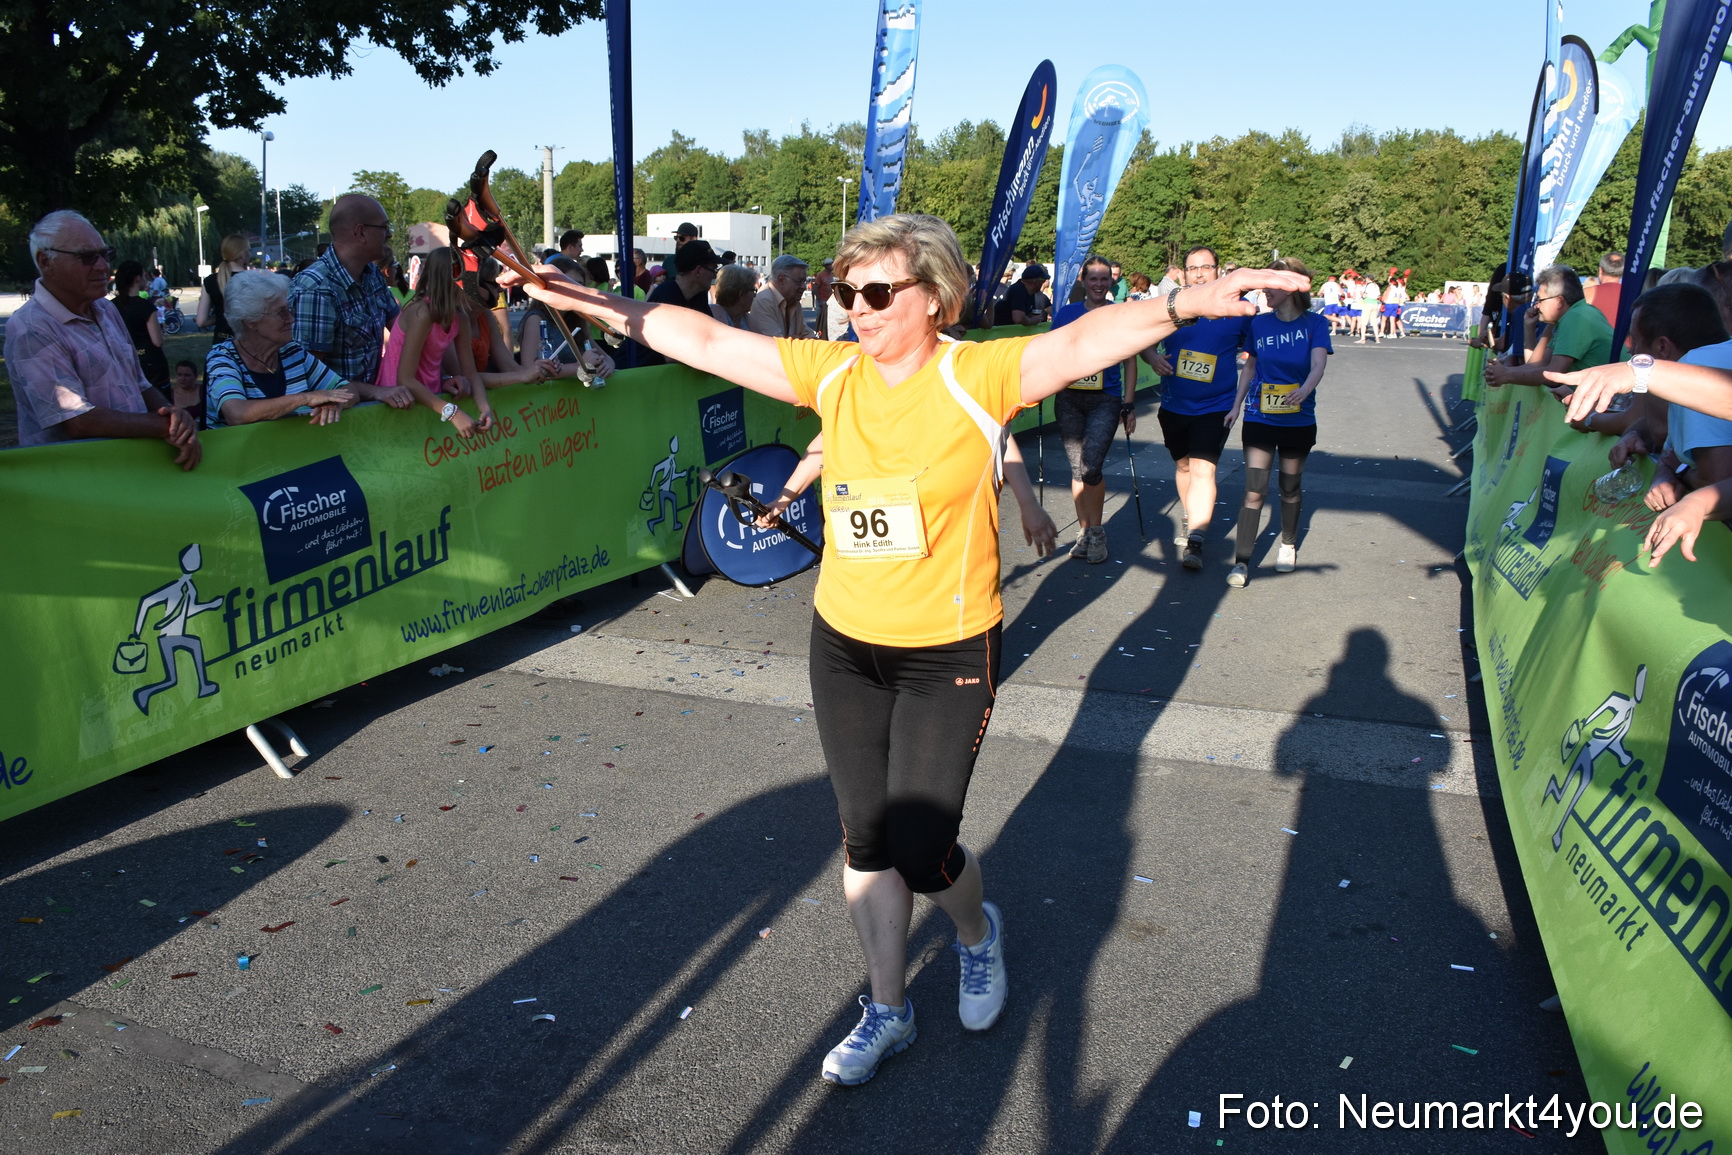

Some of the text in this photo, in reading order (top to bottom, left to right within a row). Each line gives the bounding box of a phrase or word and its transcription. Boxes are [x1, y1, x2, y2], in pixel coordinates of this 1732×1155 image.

[1556, 152, 1573, 187] Druck
[1571, 125, 1582, 151] und
[991, 135, 1035, 248] Frischmann
[1409, 314, 1450, 324] Fischer
[1182, 360, 1211, 374] 1725
[518, 397, 580, 433] Firmen
[1265, 394, 1288, 406] 172
[710, 410, 738, 429] Fischer
[477, 417, 599, 494] laufen länger!
[280, 489, 347, 524] Fischer
[290, 505, 347, 532] AUTOMOBILE
[850, 508, 889, 540] 96
[321, 528, 335, 540] das
[752, 522, 808, 553] AUTOMOILE
[853, 539, 893, 549] Hink Edith
[223, 504, 451, 654] firmenlauf
[401, 544, 611, 643] www.firmenlauf-oberpfalz.de
[235, 613, 345, 679] neumarkt
[1686, 689, 1732, 754] Fische
[1565, 842, 1650, 952] neumarkt
